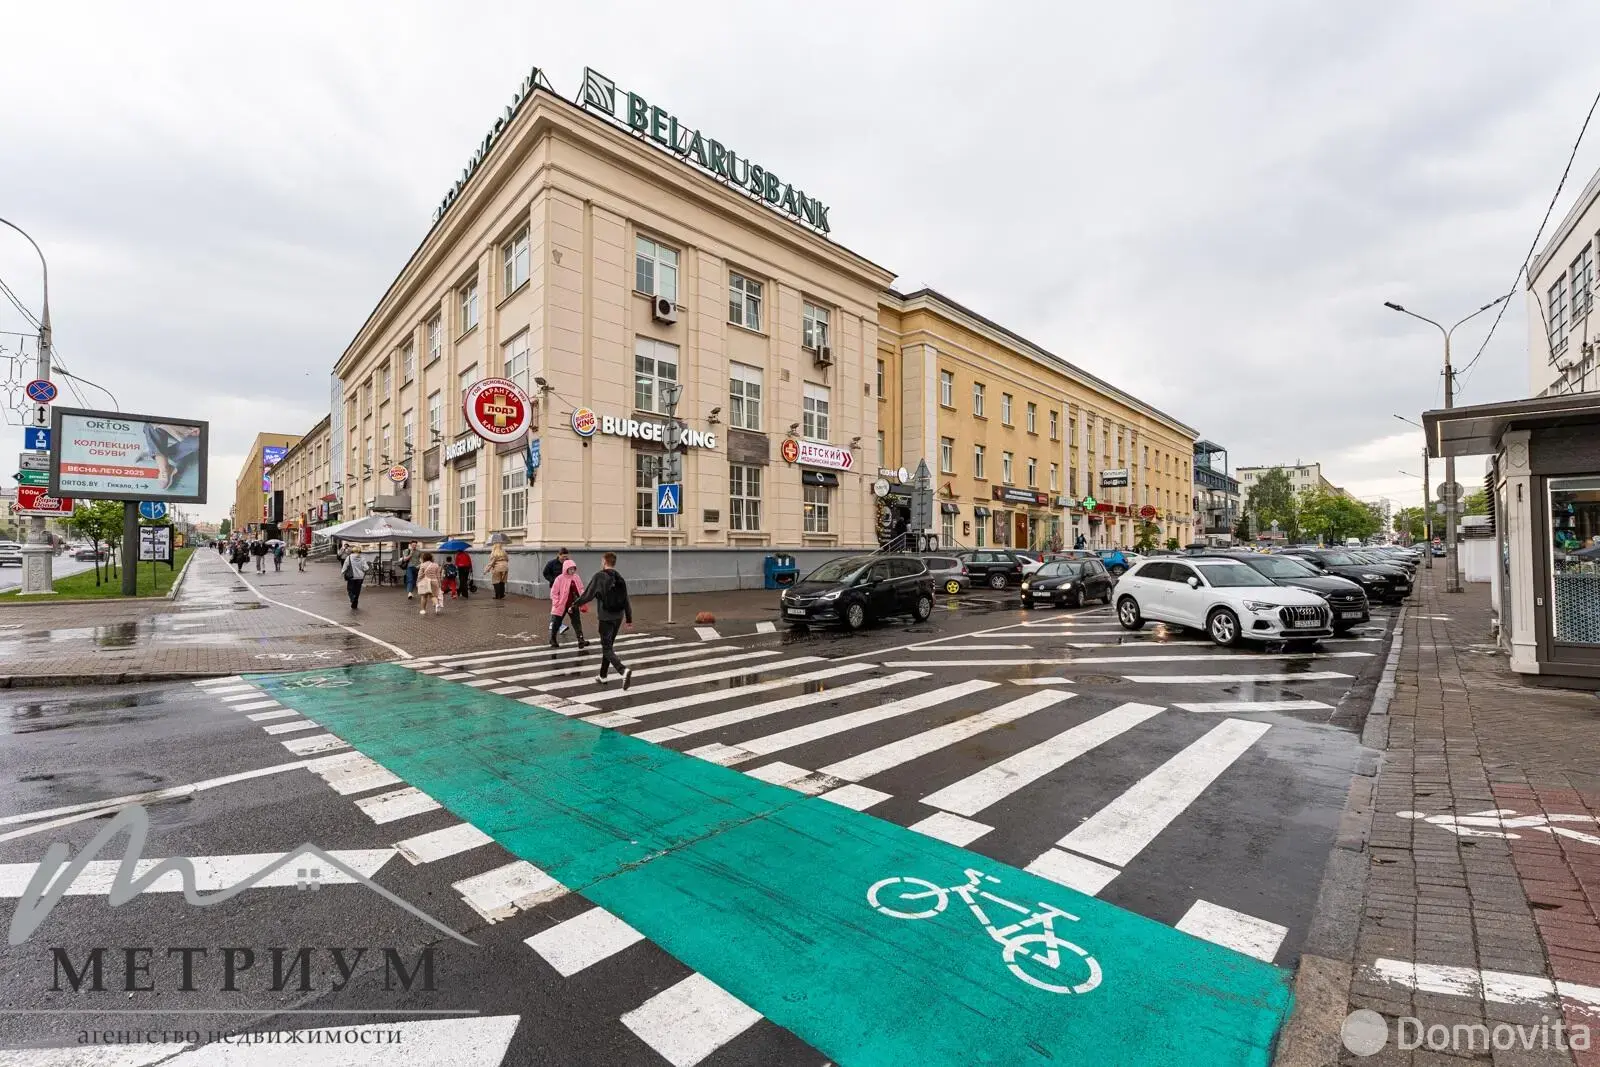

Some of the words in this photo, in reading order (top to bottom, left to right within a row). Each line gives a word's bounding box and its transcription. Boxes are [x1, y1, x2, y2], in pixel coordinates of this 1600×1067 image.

[626, 90, 831, 233] BELARUSBANK
[487, 405, 514, 415] ЛОДЭ
[575, 412, 593, 422] BURGER
[86, 420, 130, 432] ORTOS
[481, 420, 519, 434] КАЧЕСТВА
[576, 417, 595, 429] KING
[602, 415, 665, 442] BURGE
[679, 428, 716, 449] KING
[73, 439, 140, 450] КОЛЛЕКЦИЯ
[88, 448, 126, 457] ОБУВИ
[801, 445, 841, 461] ДЕТСКИЙ
[67, 465, 123, 474] ВЕСНА-ЛЕТО
[124, 468, 145, 476] 2025
[61, 479, 98, 487] ORTOS.BY
